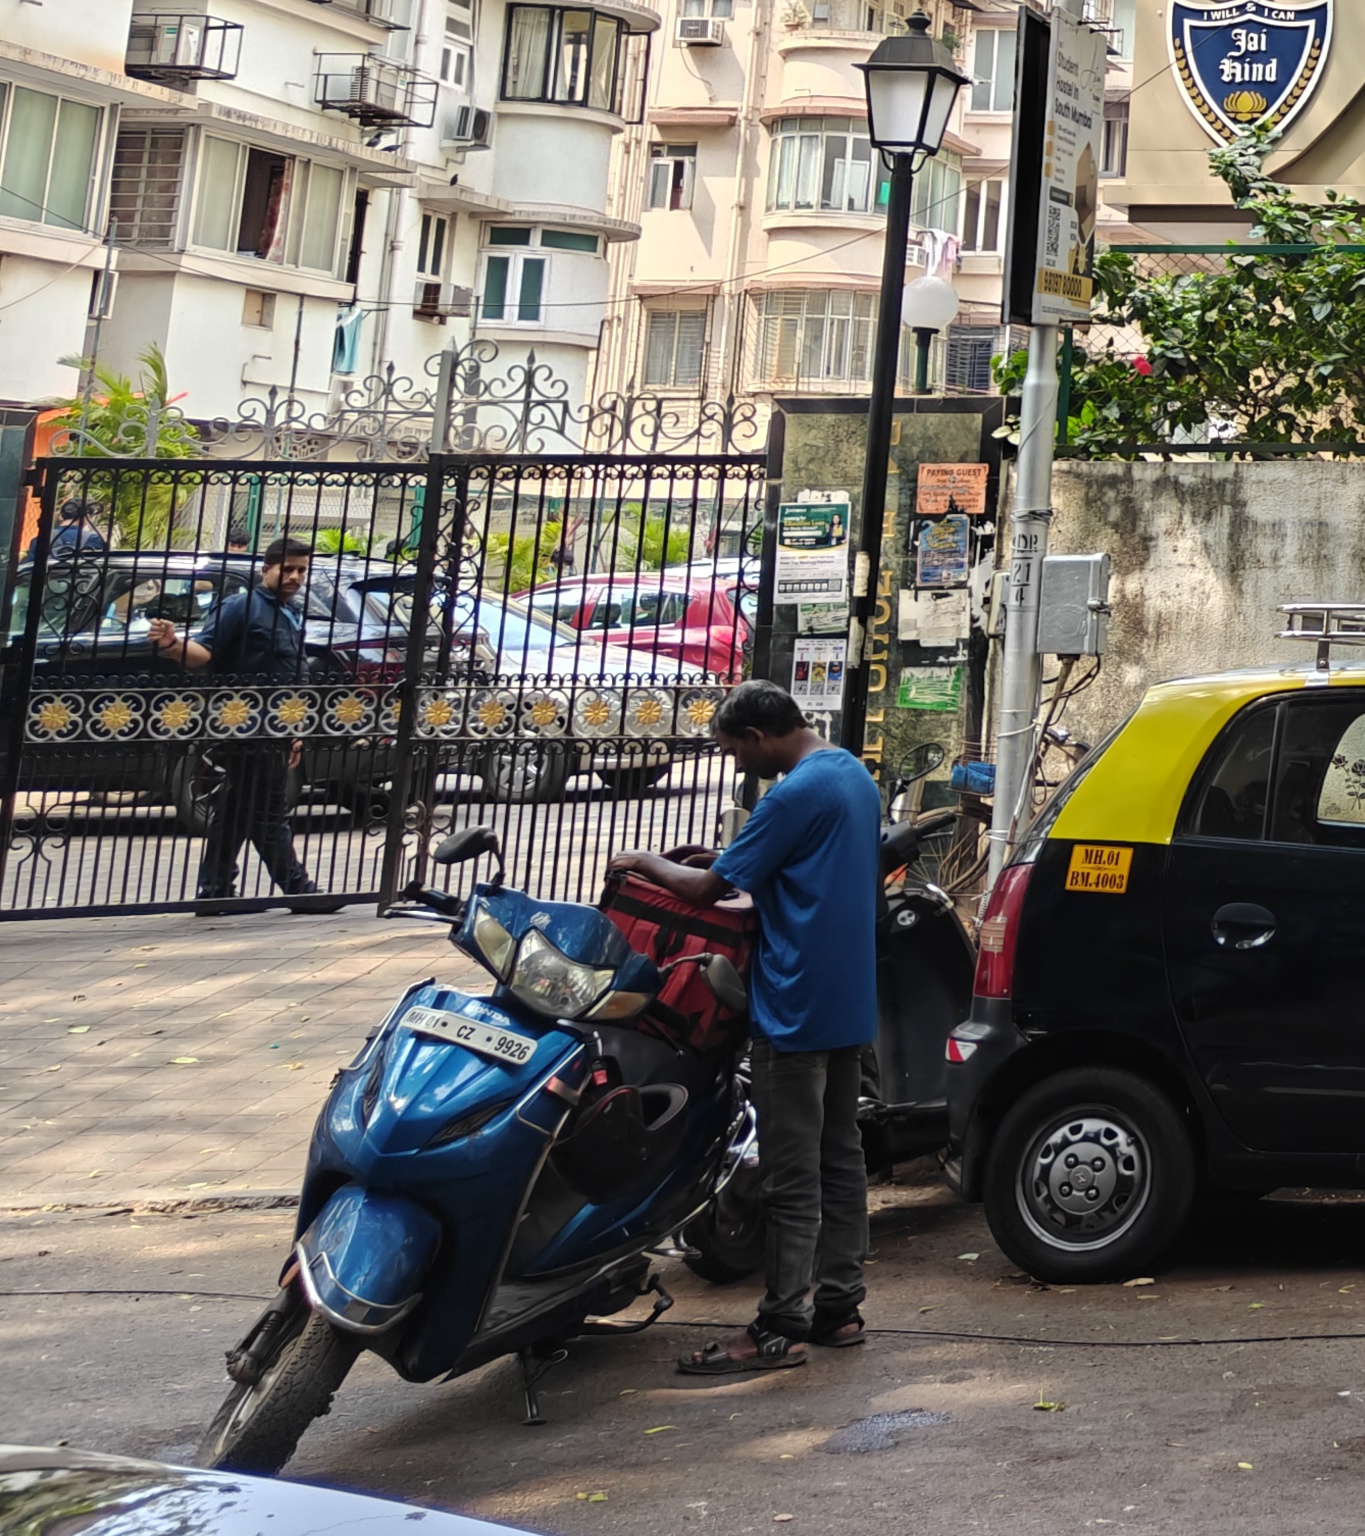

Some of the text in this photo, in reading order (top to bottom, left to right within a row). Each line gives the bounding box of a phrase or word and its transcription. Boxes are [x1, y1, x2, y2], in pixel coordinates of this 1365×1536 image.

[1211, 8, 1239, 20] WILL
[1272, 11, 1295, 20] CAN
[1227, 28, 1267, 57] Jai
[1219, 58, 1277, 83] Hind
[956, 468, 982, 477] GUEST
[1082, 848, 1121, 866] MH.01
[1069, 871, 1125, 889] BM.4003
[464, 1002, 511, 1026] ONDA
[456, 1025, 476, 1041] CZ
[494, 1036, 531, 1061] 9926
